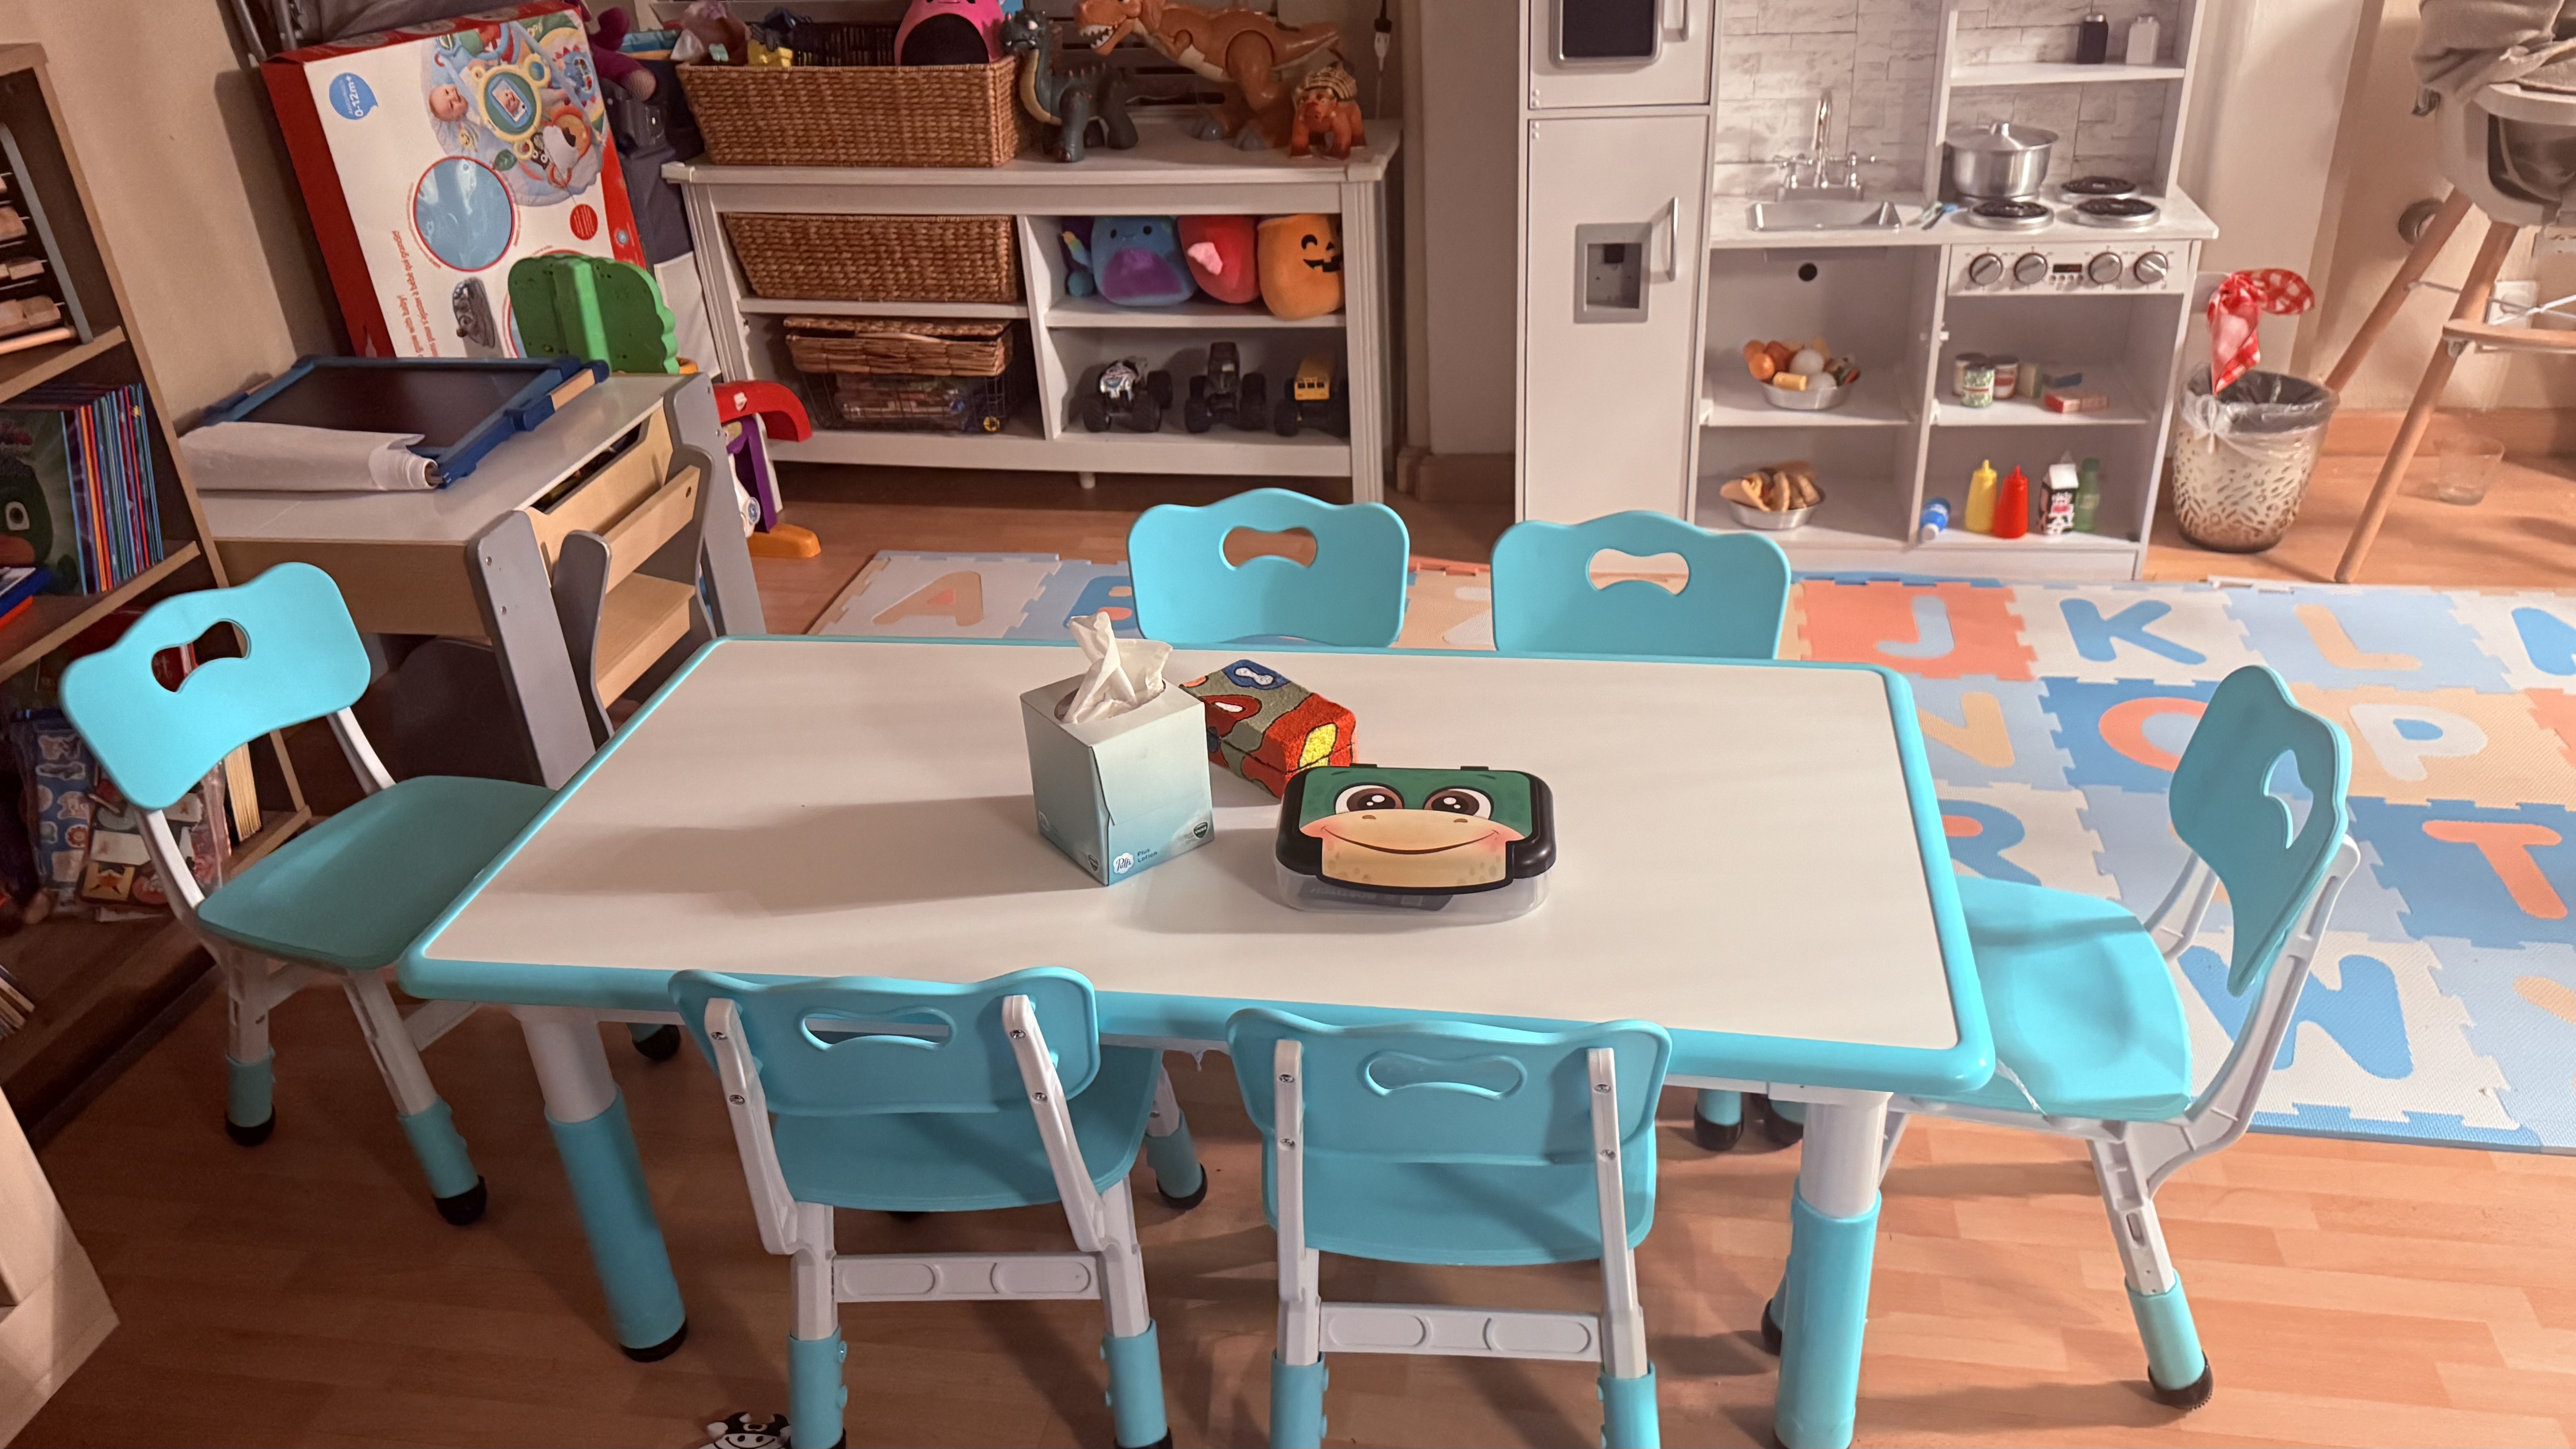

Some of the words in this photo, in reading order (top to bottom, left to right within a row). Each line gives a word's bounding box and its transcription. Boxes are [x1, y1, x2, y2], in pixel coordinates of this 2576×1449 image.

[873, 570, 984, 626] A
[1876, 595, 1955, 658] J
[2060, 598, 2207, 665] K
[2294, 604, 2422, 671] L
[2349, 703, 2487, 782] P
[1116, 858, 1131, 871] Puffs
[1138, 851, 1158, 862] Lotion
[2422, 820, 2567, 919] T
